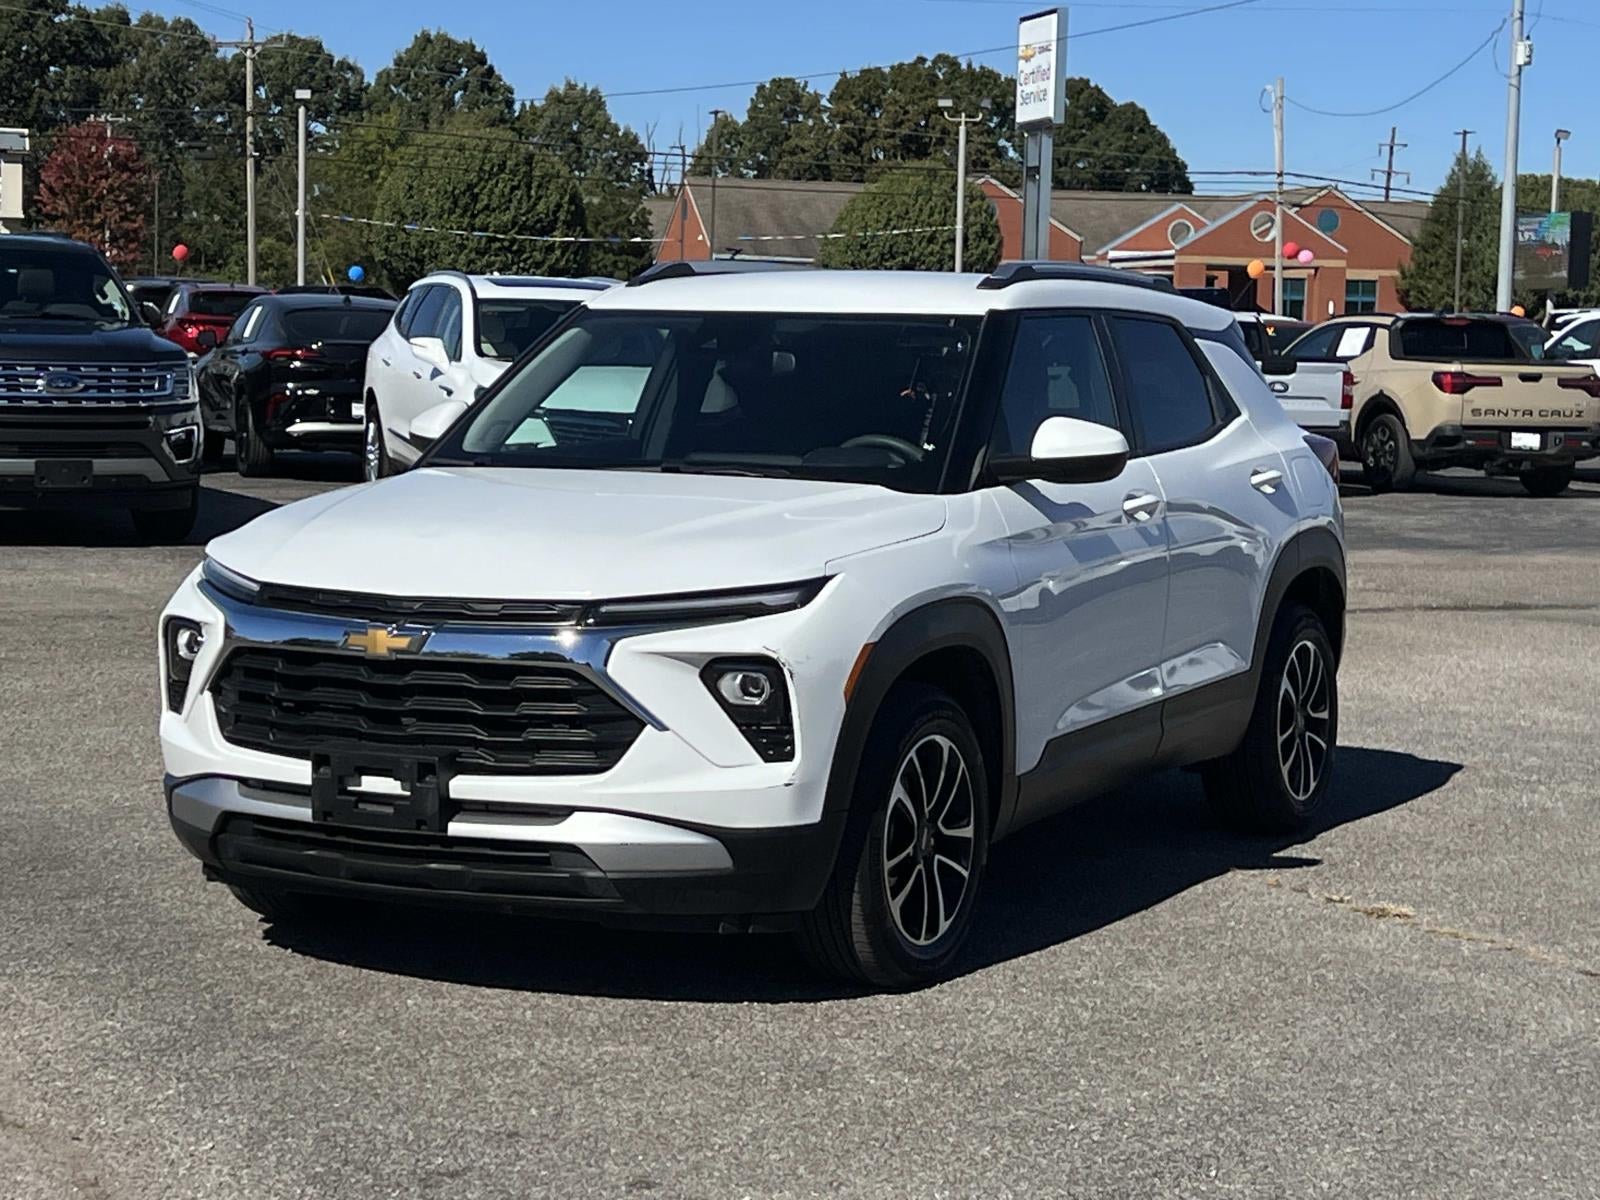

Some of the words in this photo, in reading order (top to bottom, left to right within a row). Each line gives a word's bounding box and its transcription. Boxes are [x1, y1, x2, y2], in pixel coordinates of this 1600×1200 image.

[1018, 64, 1051, 86] Certified
[1019, 88, 1048, 106] Service
[1470, 408, 1533, 418] SANTA
[1538, 409, 1585, 418] CRUZ
